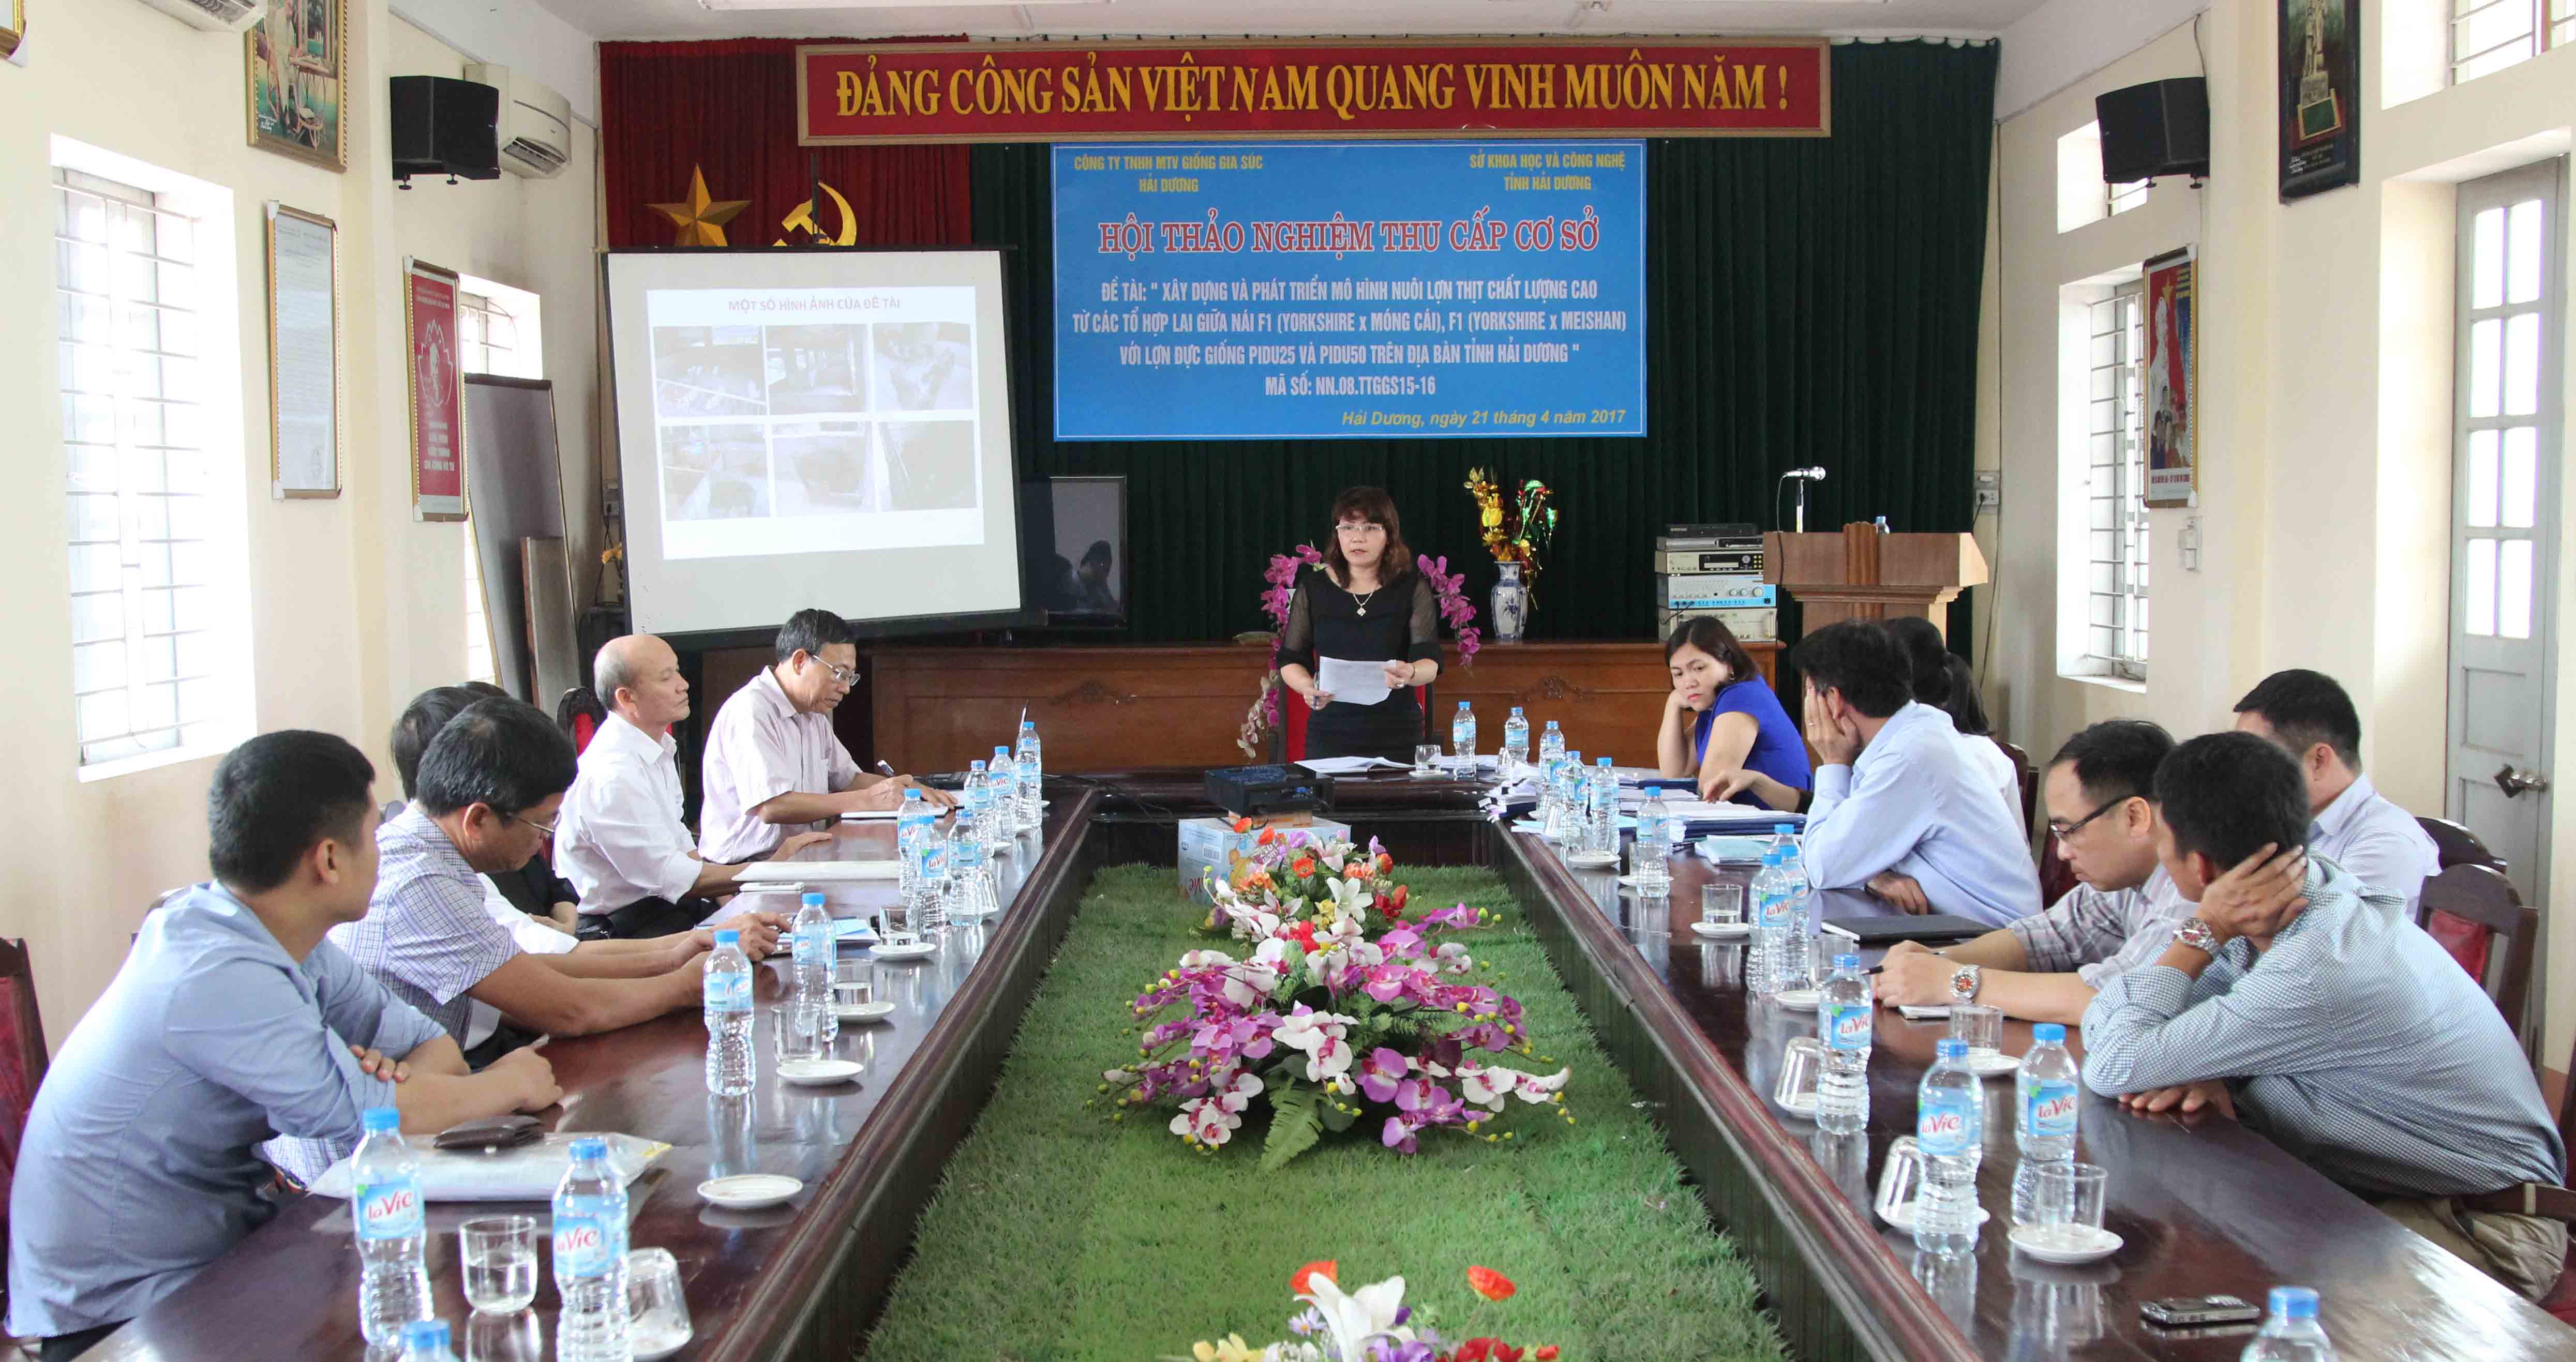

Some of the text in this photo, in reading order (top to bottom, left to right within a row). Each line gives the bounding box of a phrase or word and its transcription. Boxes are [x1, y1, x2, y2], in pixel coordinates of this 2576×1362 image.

[836, 49, 1788, 122] ĐẢNG CÔNG SẢN VIỆT NAM QUANG VINH MUÔN NĂM !
[1074, 151, 1263, 170] CÔNG TY TNHH MTV GIỐNG GIA SÚC
[1470, 149, 1626, 171] SỞ KHOA HỌC VÀ CÔNG NGHỆ
[1139, 173, 1199, 192] HẢI DƯƠNG
[1504, 171, 1592, 190] TỈNH HẢI DƯƠNG
[1098, 205, 1599, 261] HỘI THẢO NGHIỆM THU CẤP CƠ SỞ
[1101, 275, 1119, 301] ĐỀ
[1122, 279, 1147, 301] TÀI:
[1162, 278, 1188, 301] XÂY
[1191, 280, 1227, 305] DỰNG
[1232, 278, 1249, 301] VÀ
[1252, 278, 1286, 301] PHÁT
[1290, 274, 1327, 300] TRIỂN
[1331, 278, 1352, 300] MÔ
[1356, 278, 1388, 300] HÌNH
[1391, 277, 1423, 300] NUÔI
[1427, 280, 1452, 304] LỢN
[1457, 281, 1484, 304] THỊT
[1488, 274, 1521, 299] CHẤT
[1524, 279, 1567, 304] LƯỢNG
[1571, 280, 1597, 299] CAO
[1073, 309, 1090, 332] TỪ
[1092, 309, 1119, 332] CÁC
[1123, 306, 1139, 332] TỔ
[1142, 312, 1169, 336] HỢP
[1173, 313, 1193, 332] LAI
[1197, 308, 1227, 332] GIỮA
[1232, 309, 1254, 331] NÁI
[1258, 313, 1272, 331] F1
[1277, 313, 1355, 334] (YORKSHIRE
[1371, 308, 1410, 331] MÓNG
[1414, 308, 1445, 334] CÁI),
[1449, 312, 1463, 331] F1
[1469, 311, 1546, 332] (YORKSHIRE
[1561, 311, 1626, 331] MEISHAN)
[1119, 340, 1142, 364] VỚI
[1145, 345, 1171, 369] LỢN
[1205, 339, 1245, 364] GIỐNG
[1249, 345, 1296, 364] PIDU25
[1299, 341, 1316, 364] VÀ
[1320, 345, 1367, 364] PIDU50
[1370, 341, 1403, 364] TRÊN
[1407, 344, 1429, 368] ĐỊA
[1433, 341, 1460, 364] BÀN
[1464, 337, 1494, 363] TỈNH
[1498, 336, 1520, 362] HẢI
[1523, 342, 1568, 362] DƯƠNG
[1266, 370, 1436, 396] MÃ SỐ: NN.08.TTGGS15-16
[1342, 410, 1627, 428] Hải Dương, ngày 21 tháng 4 năm 2017
